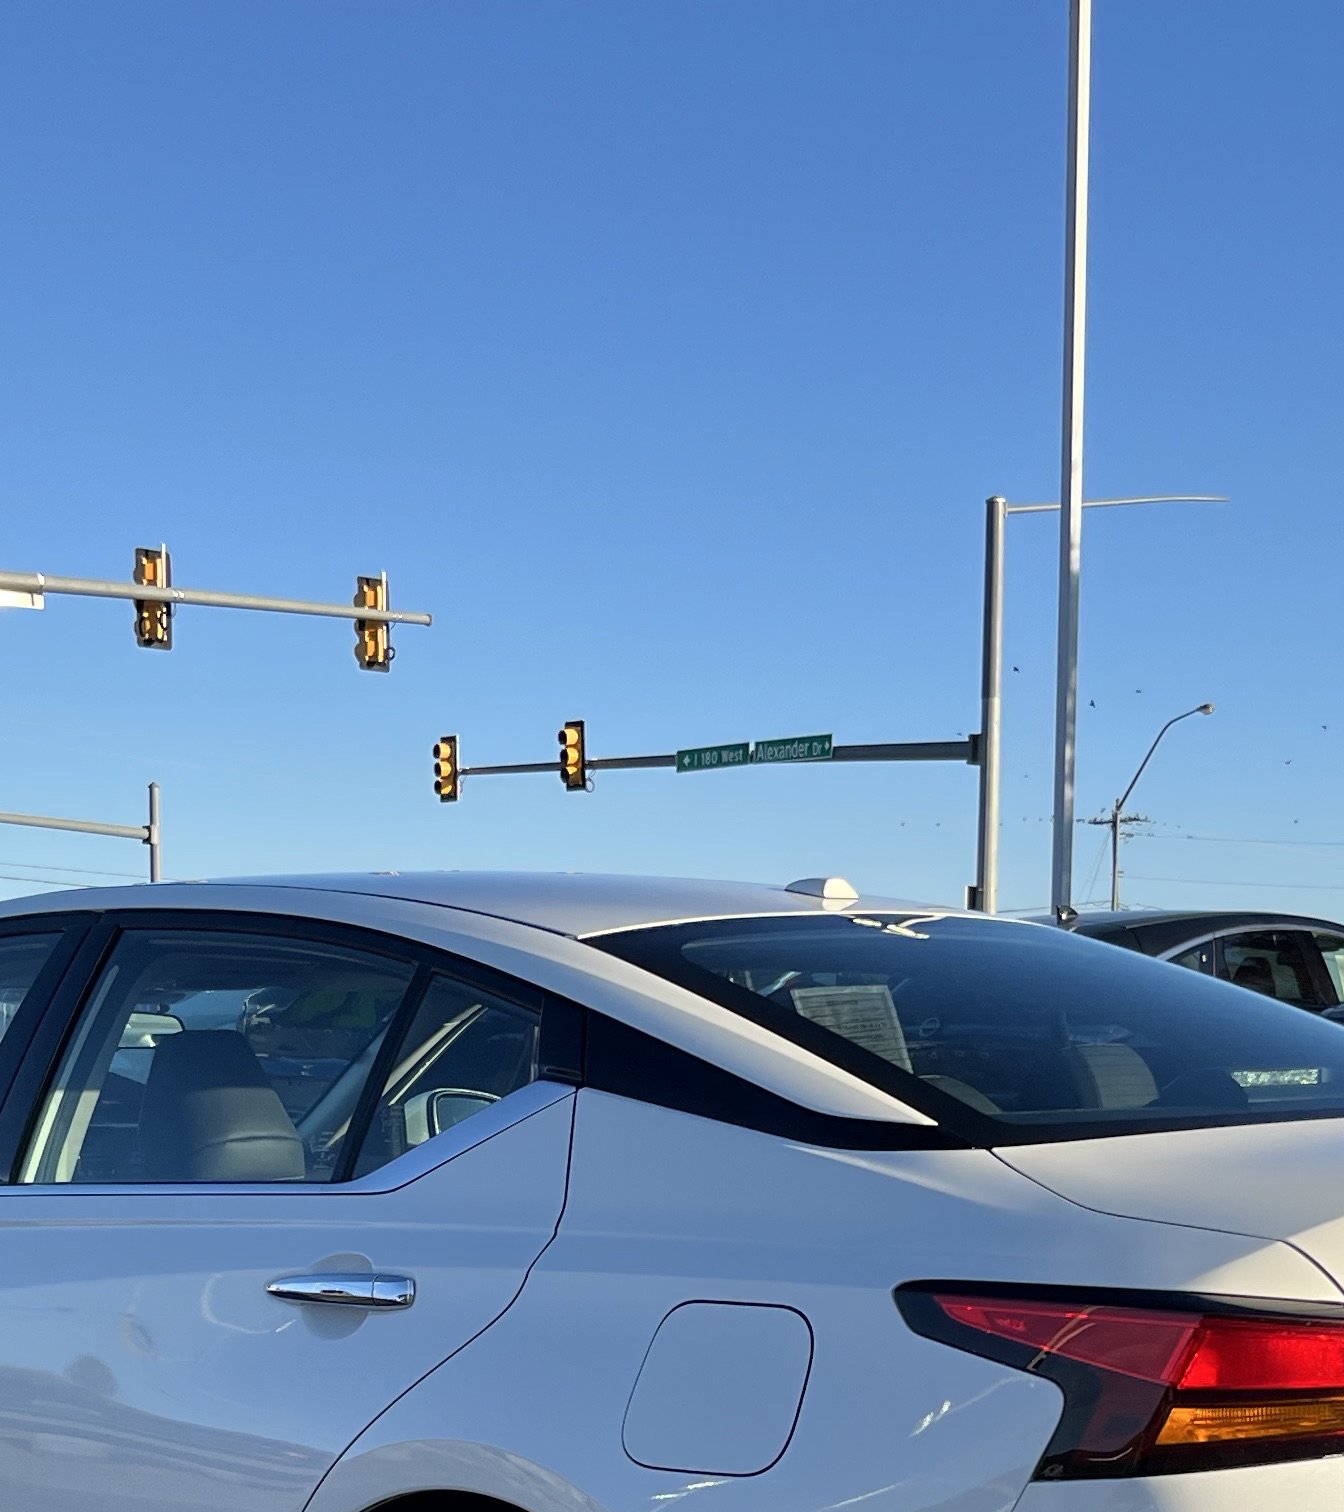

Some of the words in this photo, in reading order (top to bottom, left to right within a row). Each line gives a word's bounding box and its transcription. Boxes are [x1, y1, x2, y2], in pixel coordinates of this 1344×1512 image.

[701, 751, 718, 765] 180
[721, 749, 743, 763] West
[756, 739, 809, 761] Alexander
[812, 742, 822, 756] Dr
